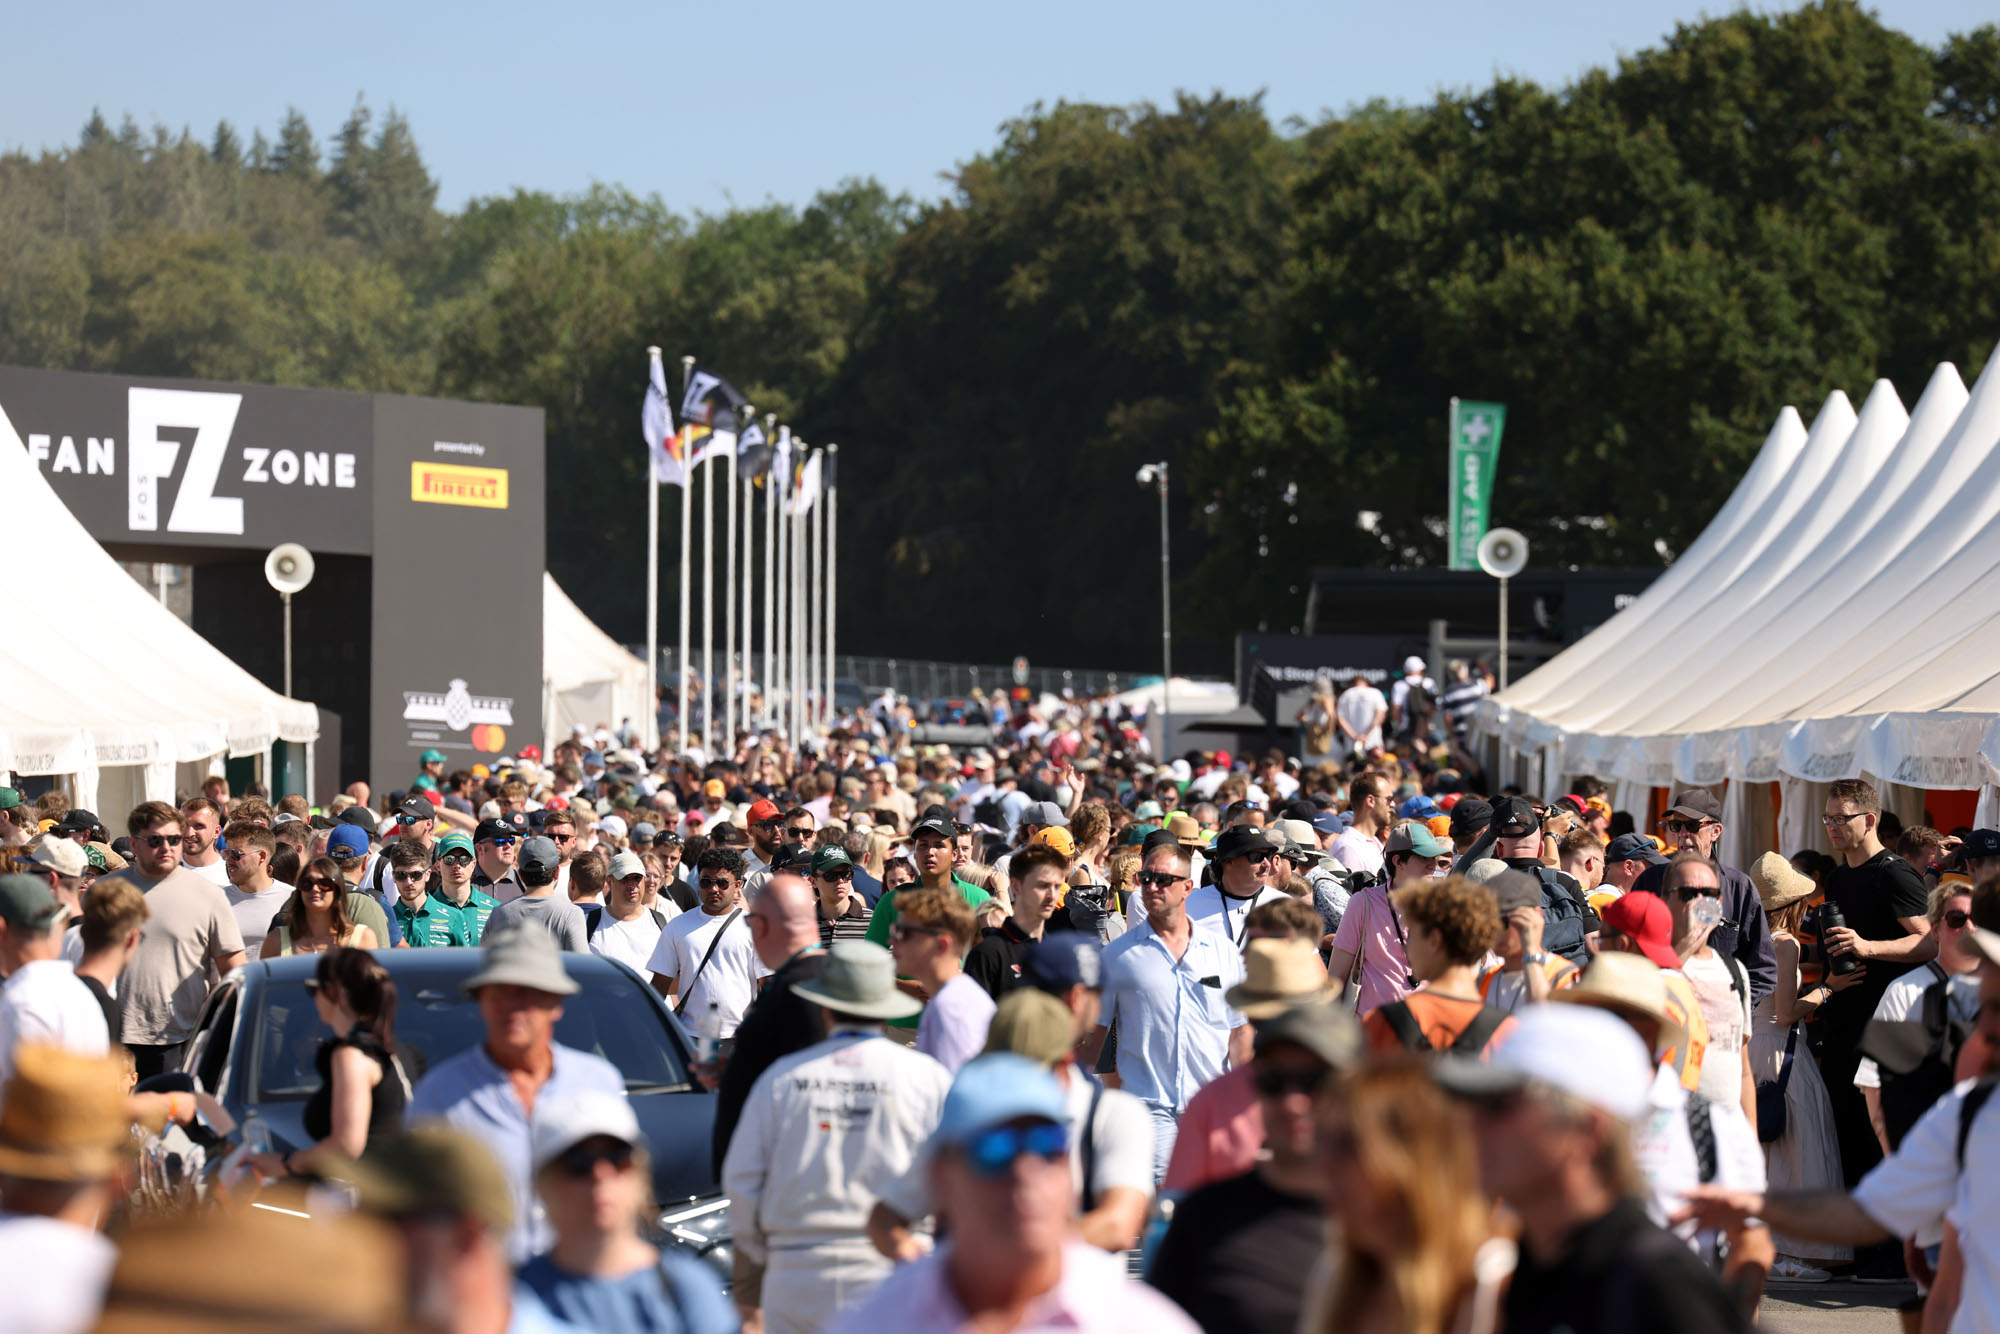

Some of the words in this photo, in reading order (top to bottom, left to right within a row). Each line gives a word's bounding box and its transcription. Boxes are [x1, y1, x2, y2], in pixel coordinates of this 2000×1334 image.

[28, 433, 115, 475] FAN
[242, 447, 356, 488] ZONE
[1463, 453, 1480, 501] AID
[138, 474, 149, 521] FOS
[423, 472, 498, 499] PIRELLI
[1283, 666, 1315, 682] Stop
